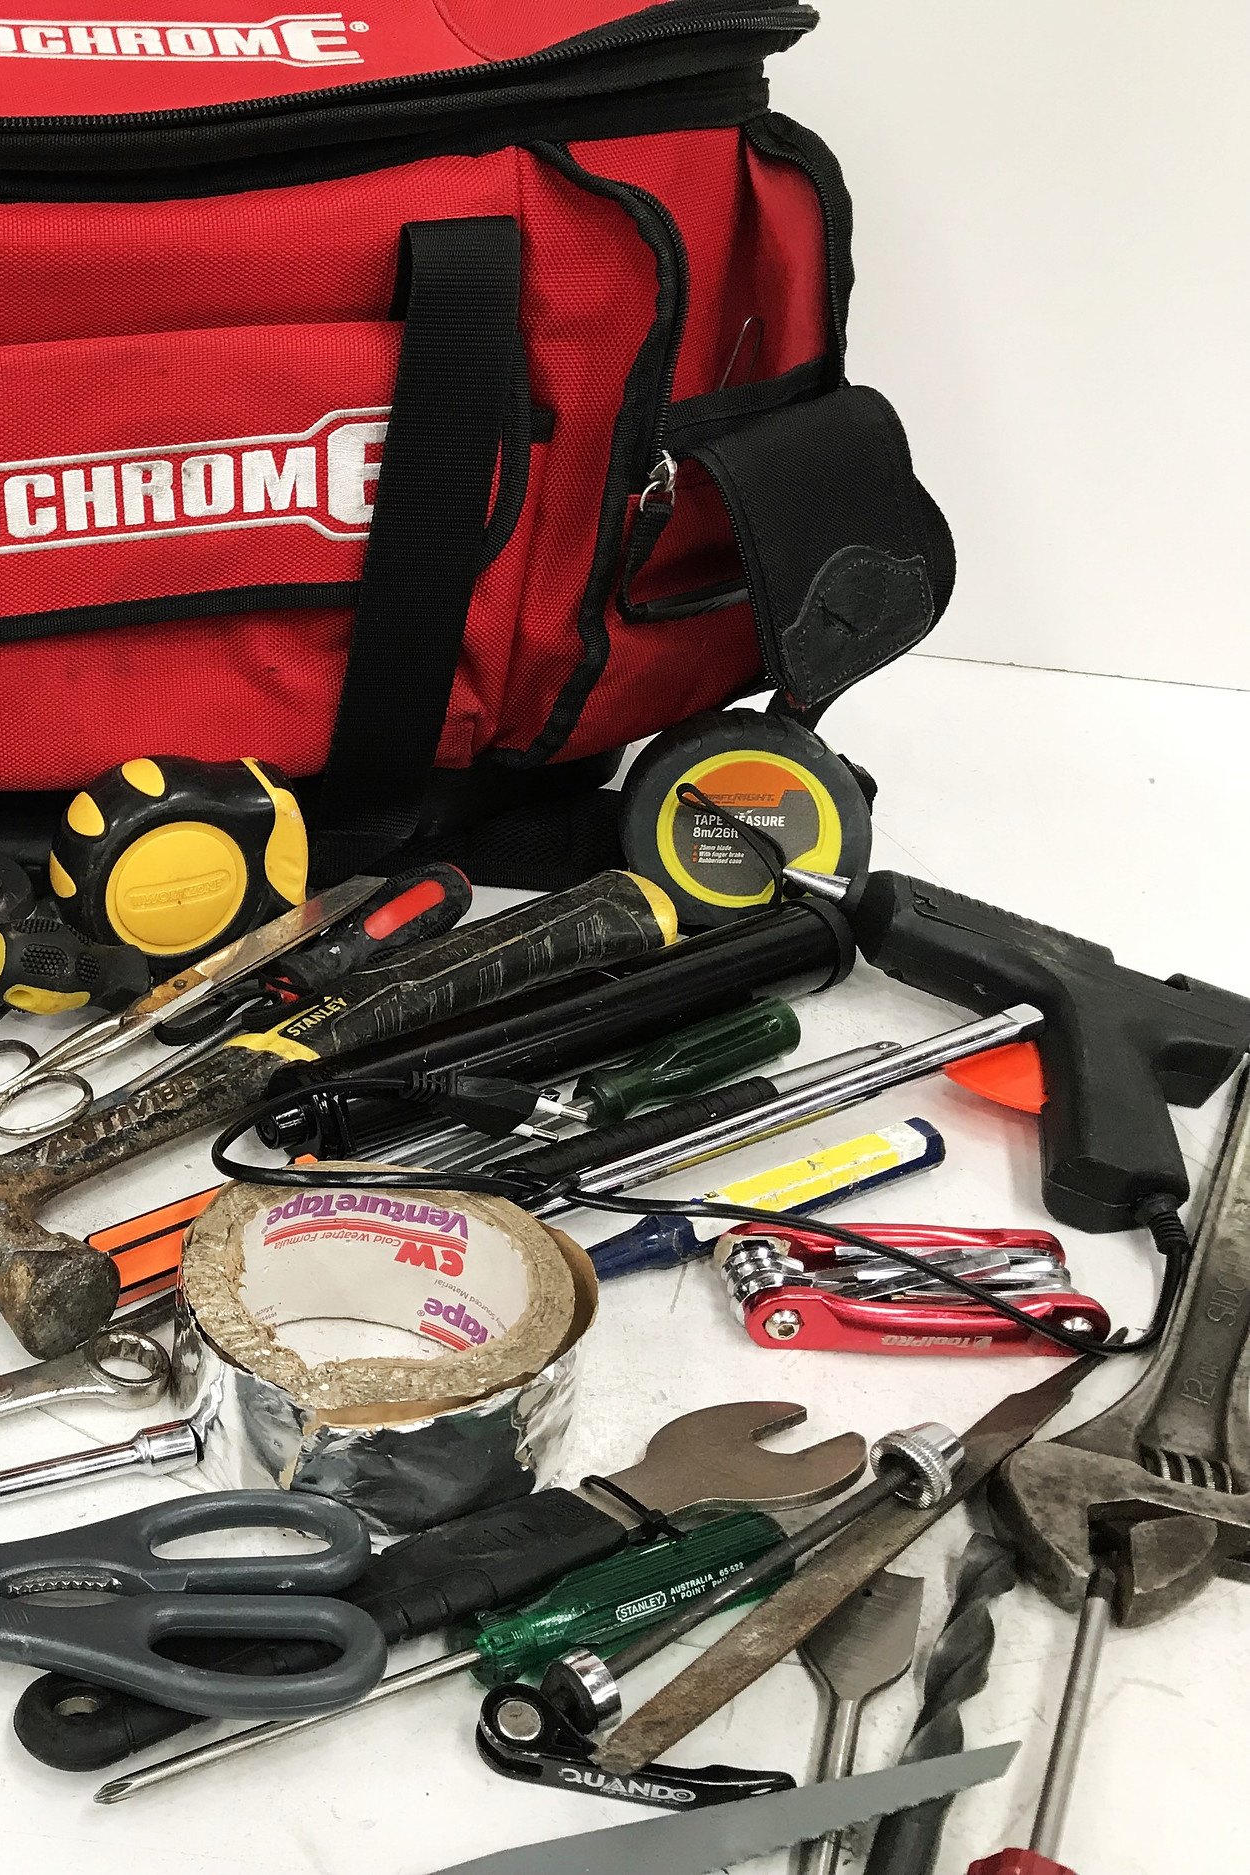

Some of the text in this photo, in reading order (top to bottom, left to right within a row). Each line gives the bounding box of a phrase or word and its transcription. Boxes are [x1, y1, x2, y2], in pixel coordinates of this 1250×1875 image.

[693, 814, 786, 827] TAPE EASURE
[693, 827, 739, 839] 8m/26ft
[286, 996, 348, 1037] STANLEY
[267, 1193, 468, 1240] VentureTape
[274, 1230, 401, 1249] Cold Weather Formula
[394, 1241, 464, 1277] CW
[434, 1279, 495, 1321] Material Sourced
[670, 1573, 713, 1595] AUSTRALIA
[680, 1585, 706, 1600] POINT
[620, 1595, 662, 1618] STANLEY
[558, 1767, 696, 1802] QUANDO
